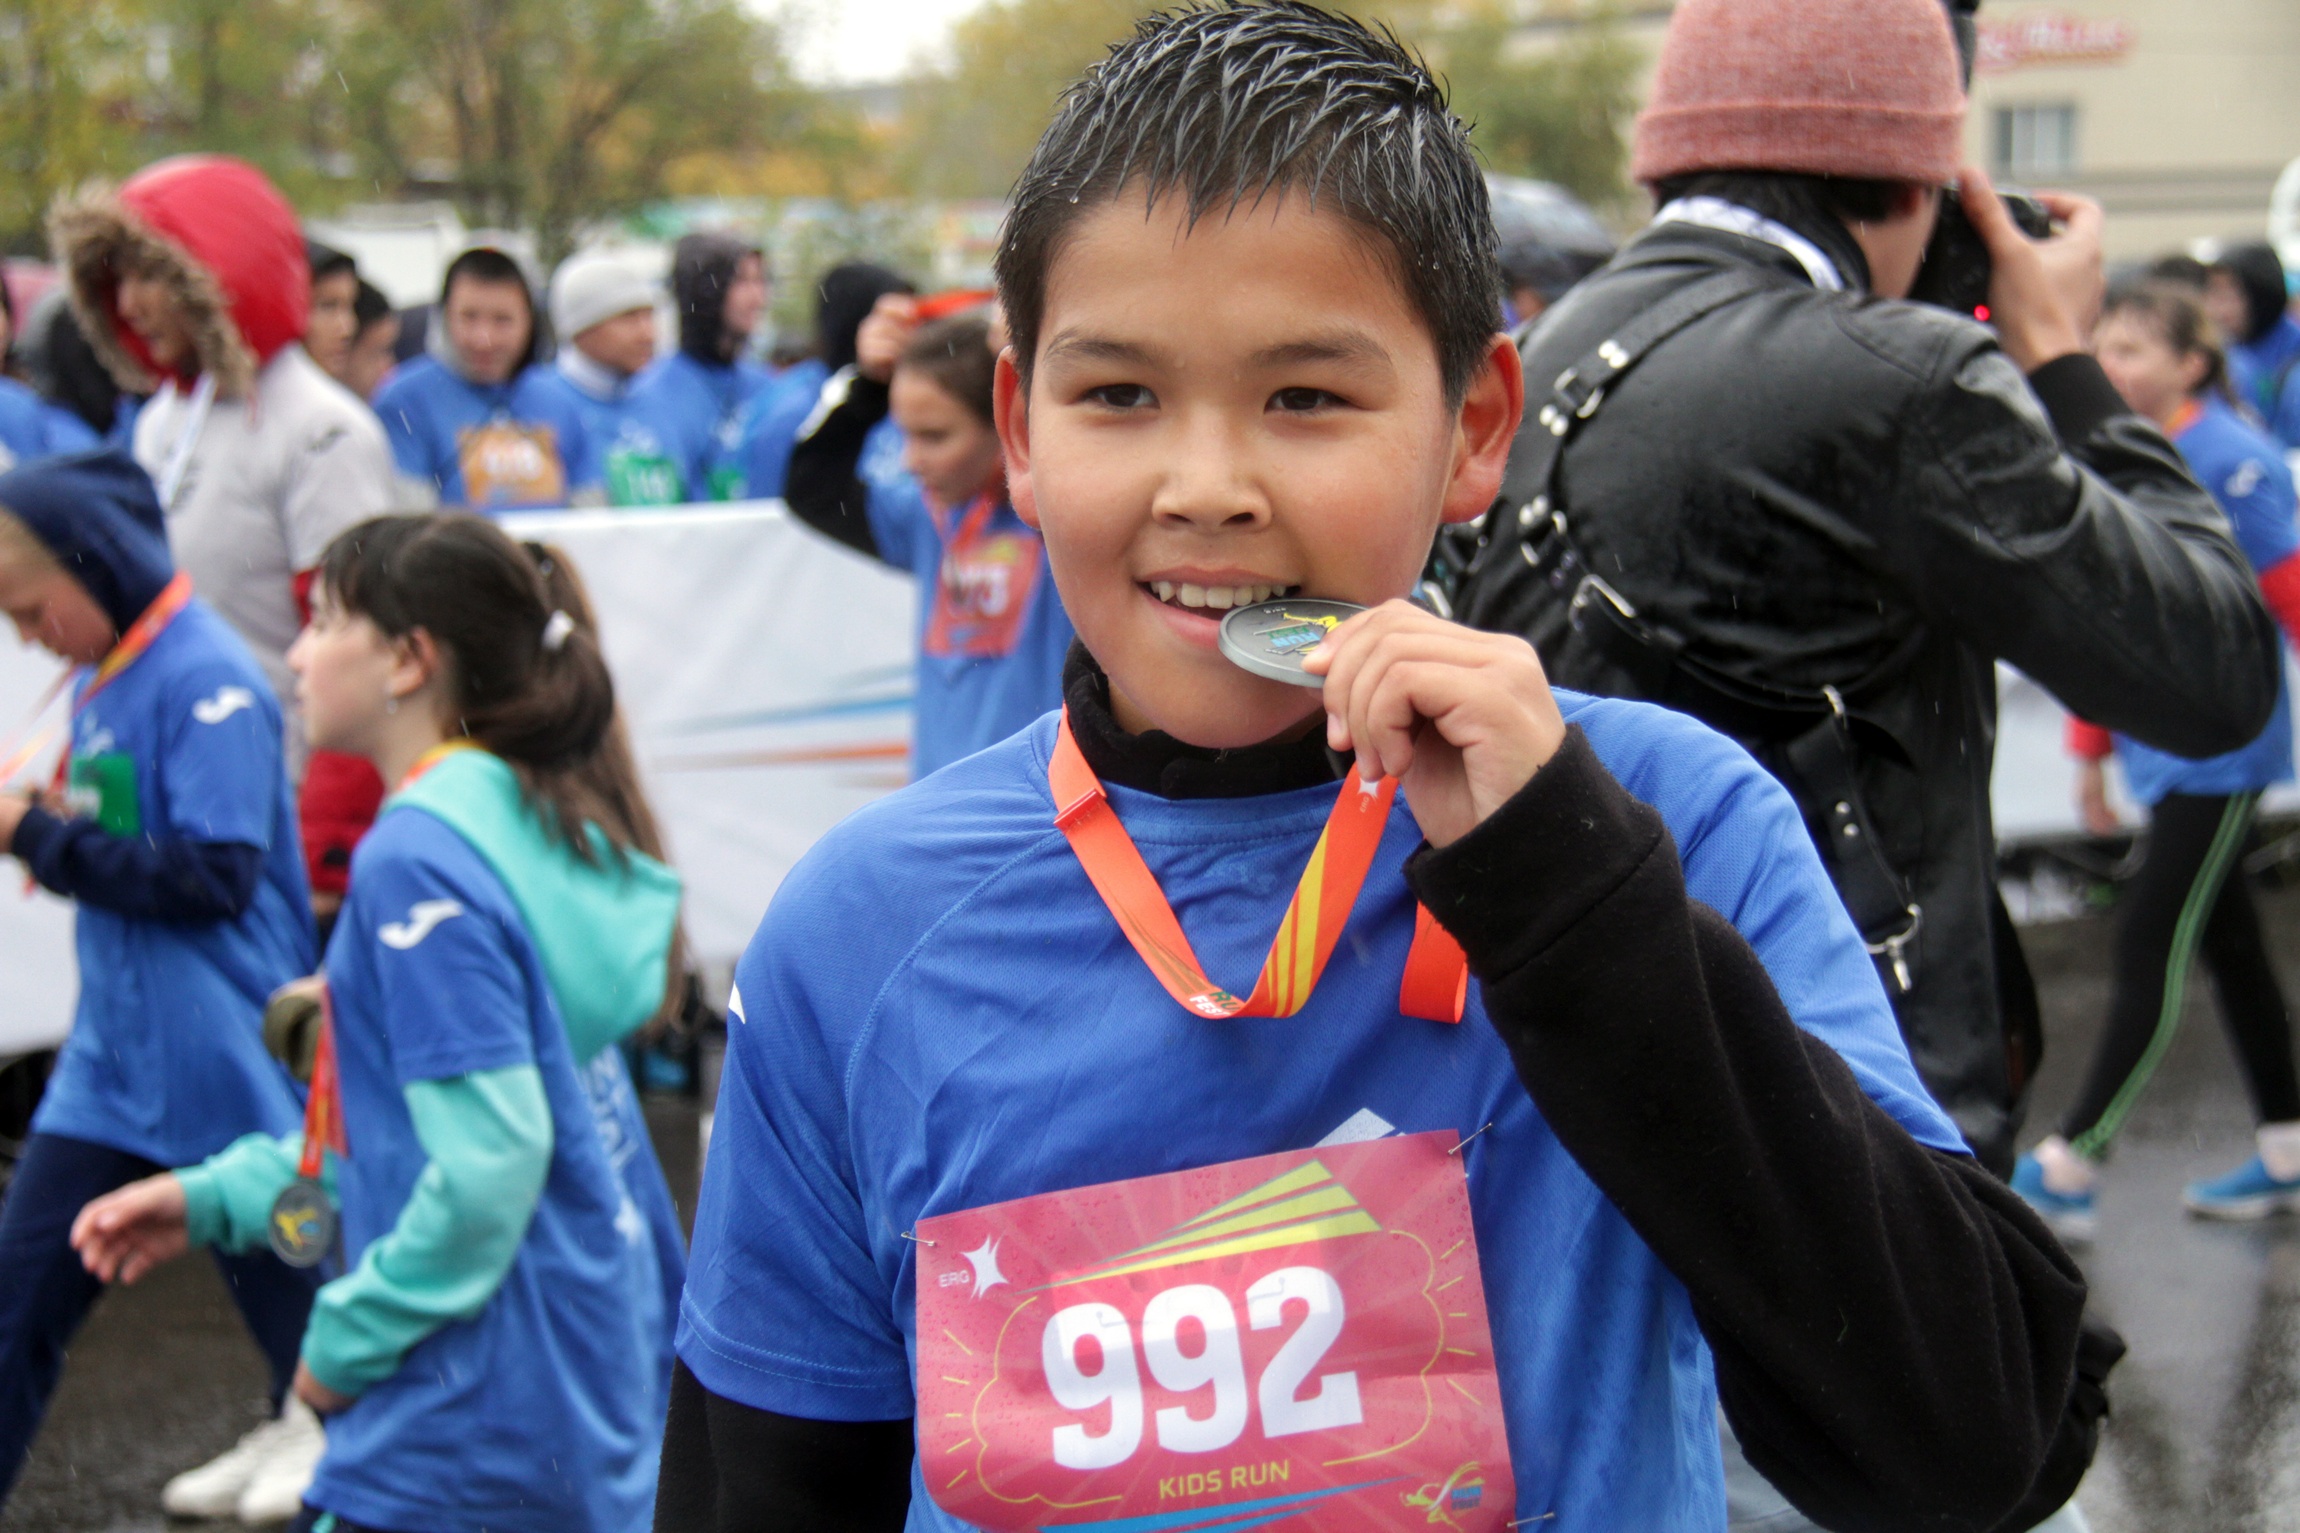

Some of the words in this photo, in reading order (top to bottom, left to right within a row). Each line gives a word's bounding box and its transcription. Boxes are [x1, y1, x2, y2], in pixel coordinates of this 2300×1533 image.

[938, 1269, 970, 1288] ERG
[1042, 1265, 1363, 1470] 992
[1159, 1469, 1223, 1499] KIDS
[1230, 1459, 1289, 1489] RUN
